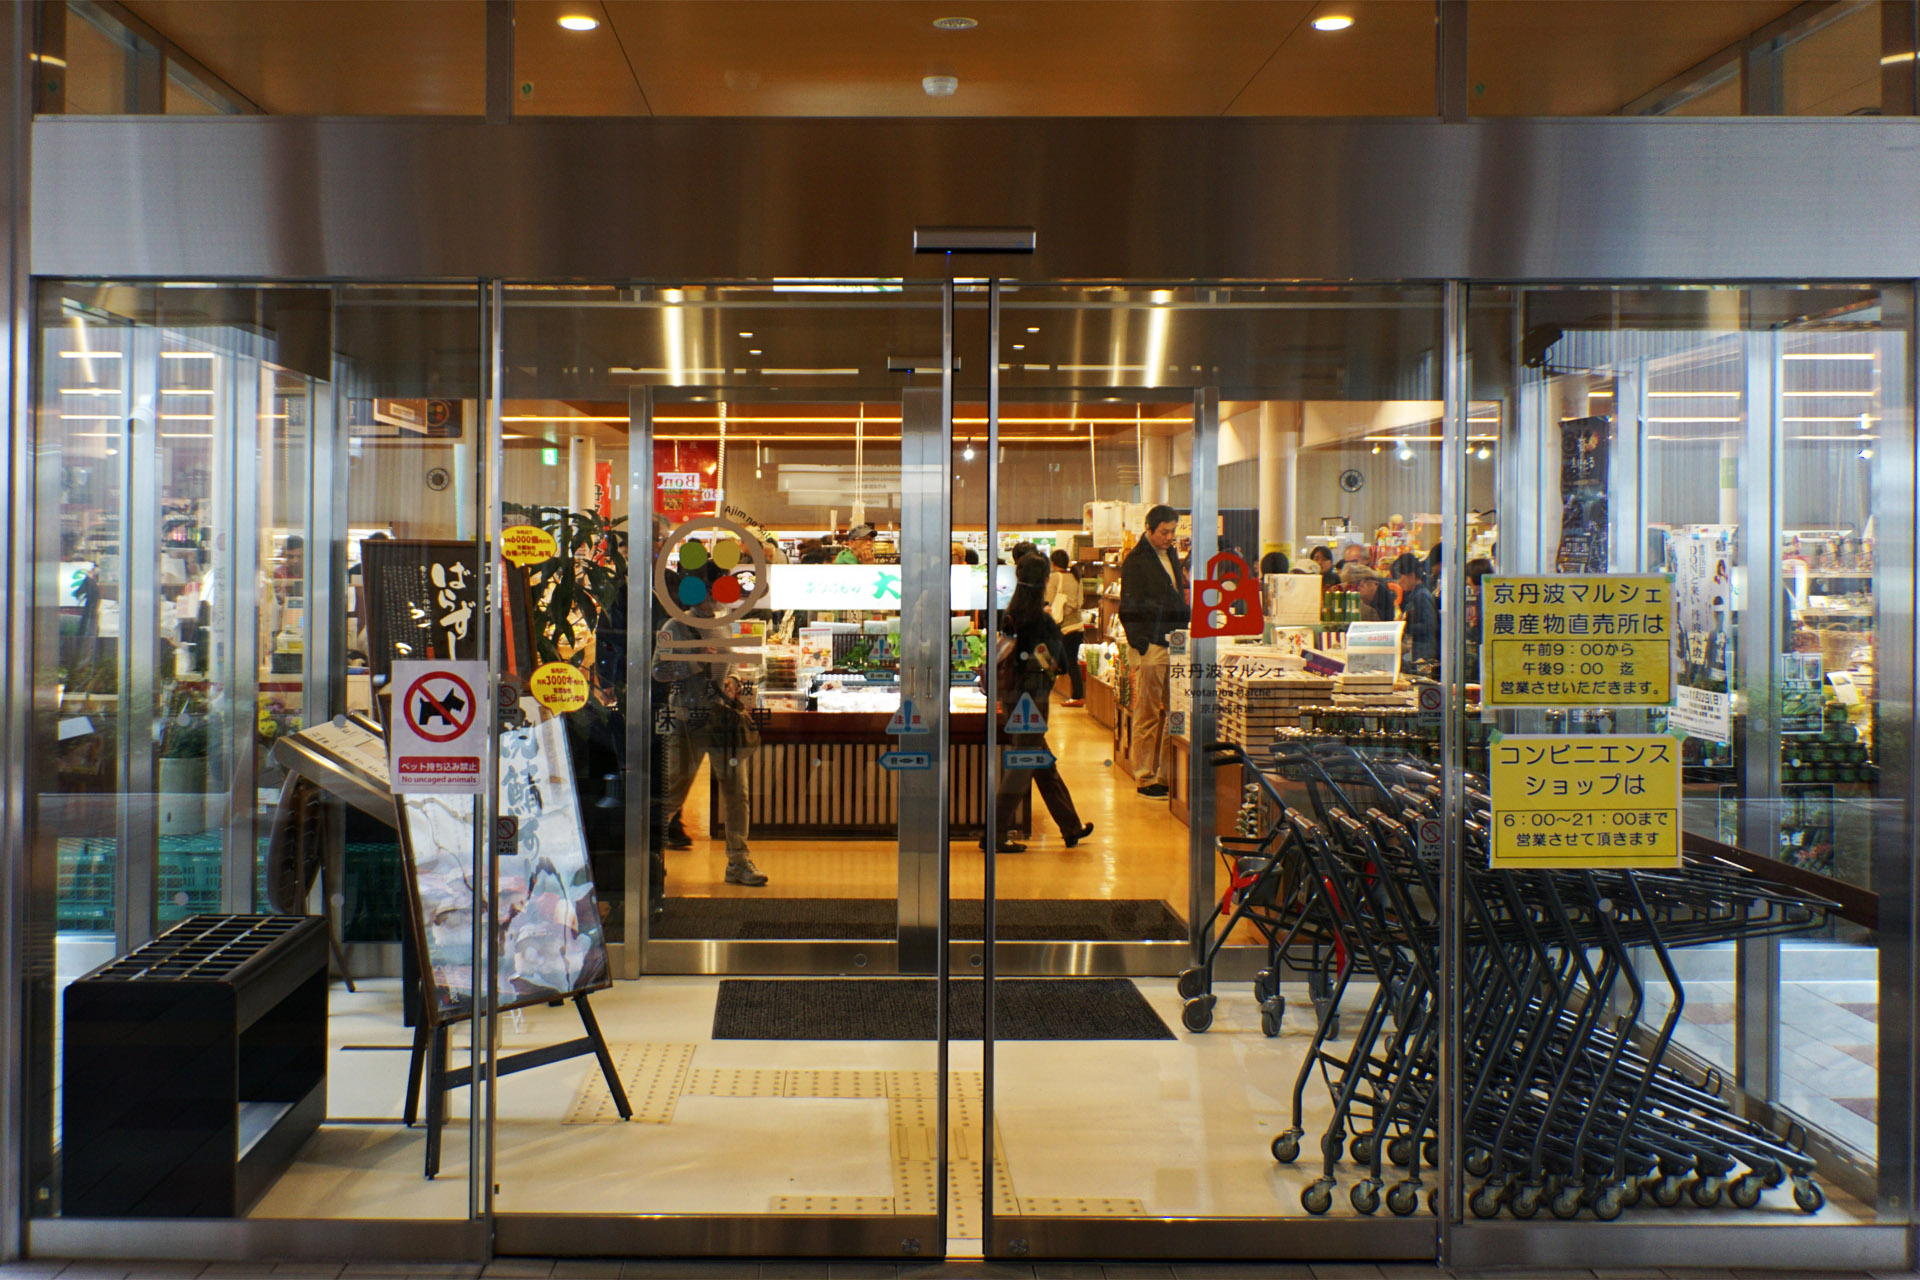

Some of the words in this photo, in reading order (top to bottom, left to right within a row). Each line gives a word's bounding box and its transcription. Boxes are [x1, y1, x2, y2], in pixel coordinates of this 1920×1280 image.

[723, 505, 746, 519] Ajim
[1492, 583, 1662, 604] 京丹波マルシェ
[1493, 613, 1665, 635] 農産物直売所は
[1170, 662, 1285, 679] 京丹波マルシェ
[1500, 681, 1660, 696] 営業させいただきます。
[894, 715, 921, 725] 注意
[1012, 714, 1040, 724] 注意
[1500, 744, 1670, 765] コンビニエンス
[401, 761, 477, 772] ペット持ち込み禁止
[413, 775, 447, 785] uncaged
[447, 775, 477, 784] animals
[1525, 774, 1646, 796] ショップは
[1516, 833, 1660, 848] 営業させて頂きます
